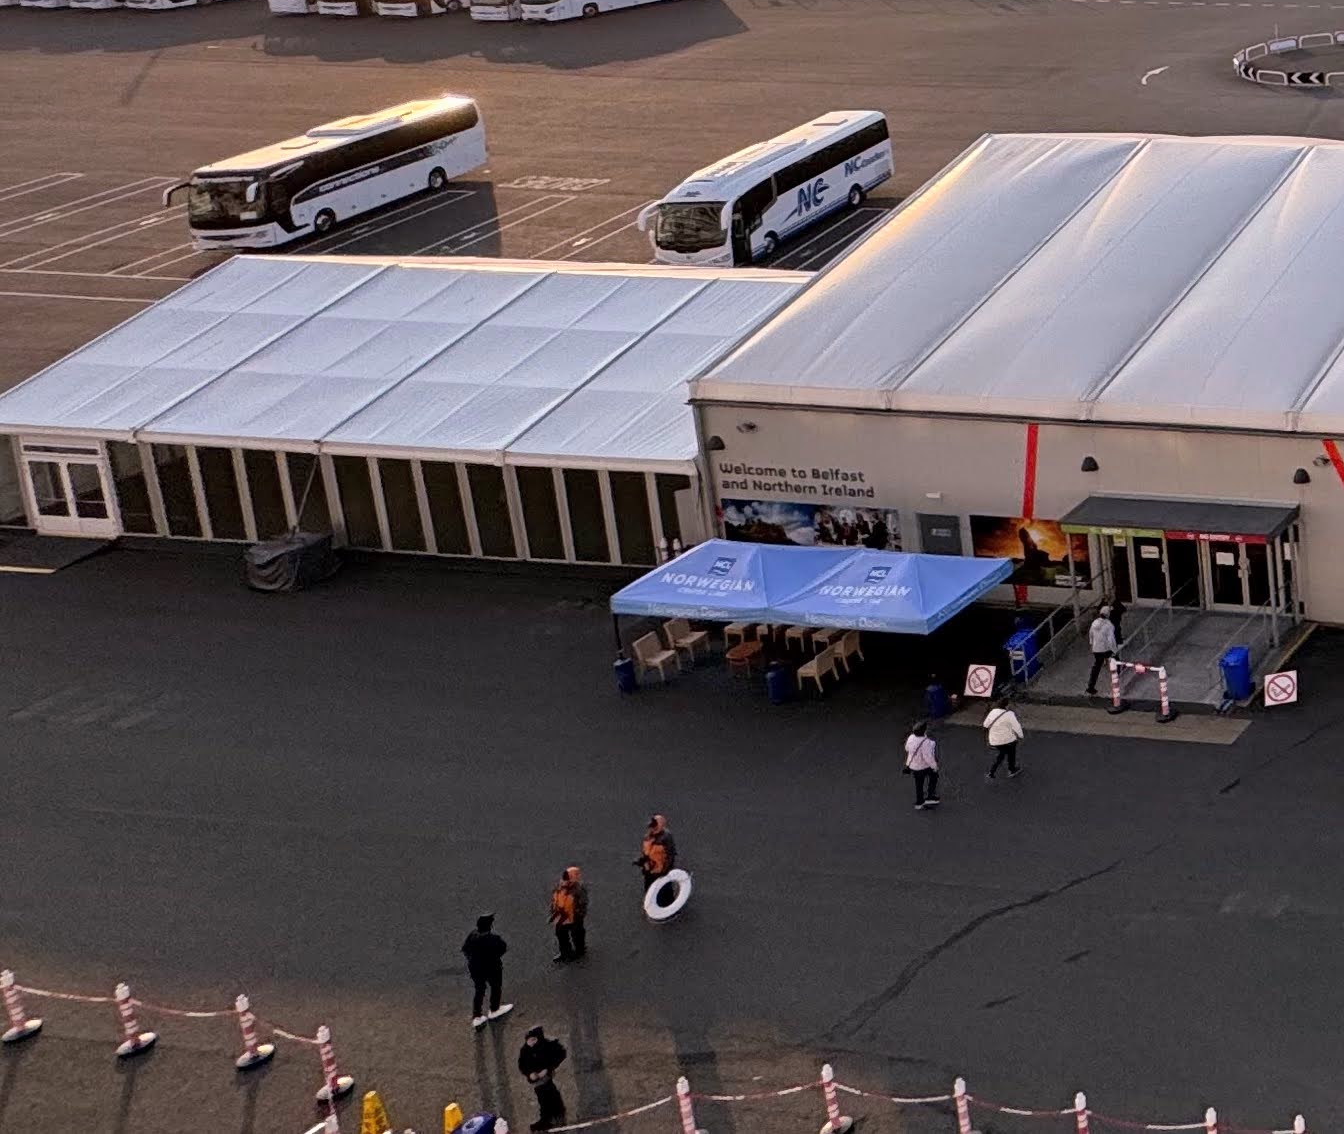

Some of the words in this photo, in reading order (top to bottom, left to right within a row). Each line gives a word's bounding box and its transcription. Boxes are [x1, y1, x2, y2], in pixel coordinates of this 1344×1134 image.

[719, 462, 787, 478] Welcome
[791, 468, 807, 479] to
[812, 468, 865, 483] Belfast
[722, 479, 748, 490] and
[753, 480, 817, 495] Northern
[821, 484, 875, 498] Ireland
[660, 572, 755, 592] NORWEGIAN
[818, 584, 912, 597] NORWEGIAN
